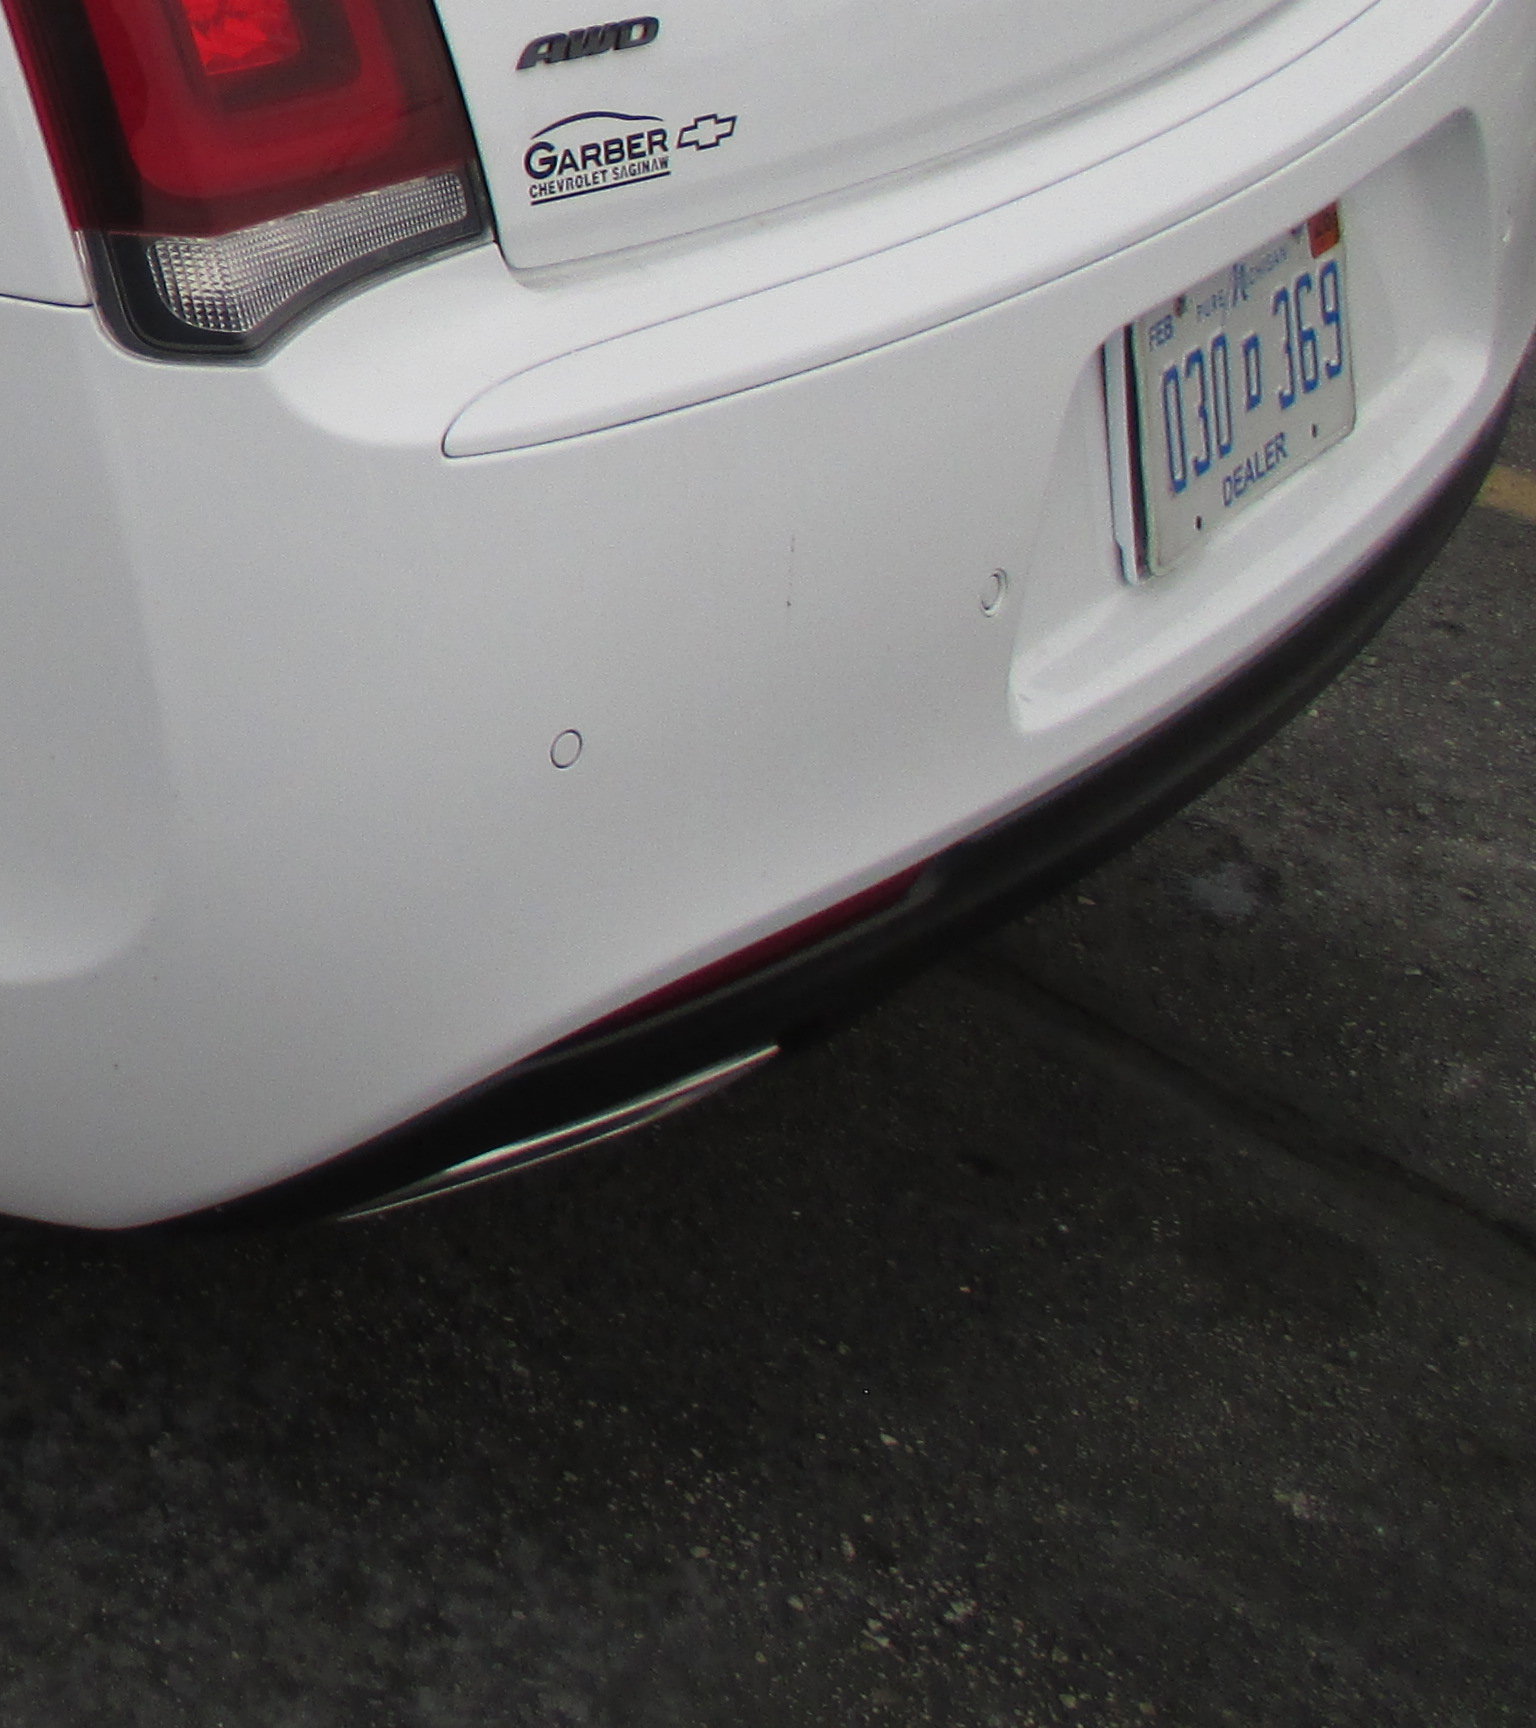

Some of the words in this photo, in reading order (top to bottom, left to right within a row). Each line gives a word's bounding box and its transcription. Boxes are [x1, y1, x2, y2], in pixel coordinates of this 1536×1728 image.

[515, 15, 660, 71] AWD
[524, 129, 668, 179] GARBER
[528, 168, 609, 199] CHEVROLET
[611, 155, 670, 181] SAGINAW
[1161, 330, 1234, 494] 030
[1271, 259, 1344, 411] 369
[1221, 431, 1289, 507] DEALER
